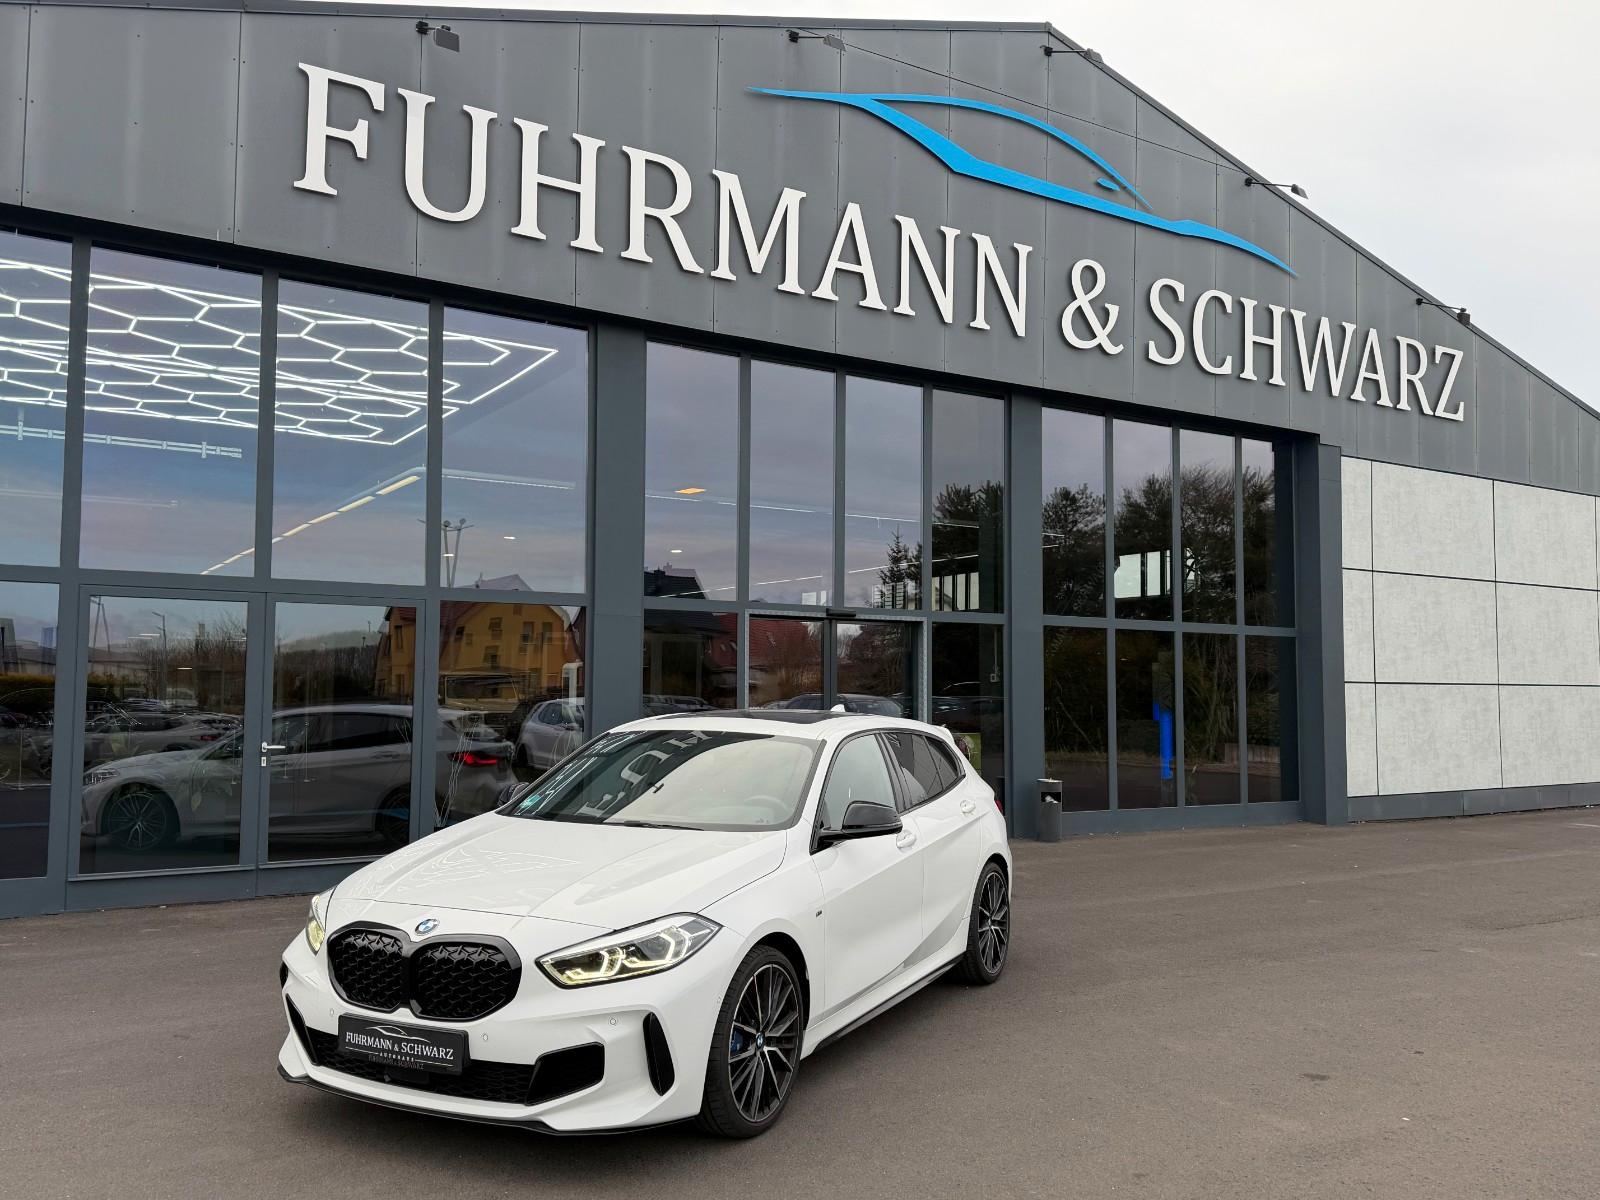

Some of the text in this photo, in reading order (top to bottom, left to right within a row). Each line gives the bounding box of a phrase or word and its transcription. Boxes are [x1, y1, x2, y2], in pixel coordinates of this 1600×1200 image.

[294, 62, 1464, 421] FUHRMANN & SCHWARZ
[346, 1032, 454, 1060] FUHRMANN & SCHWARZ
